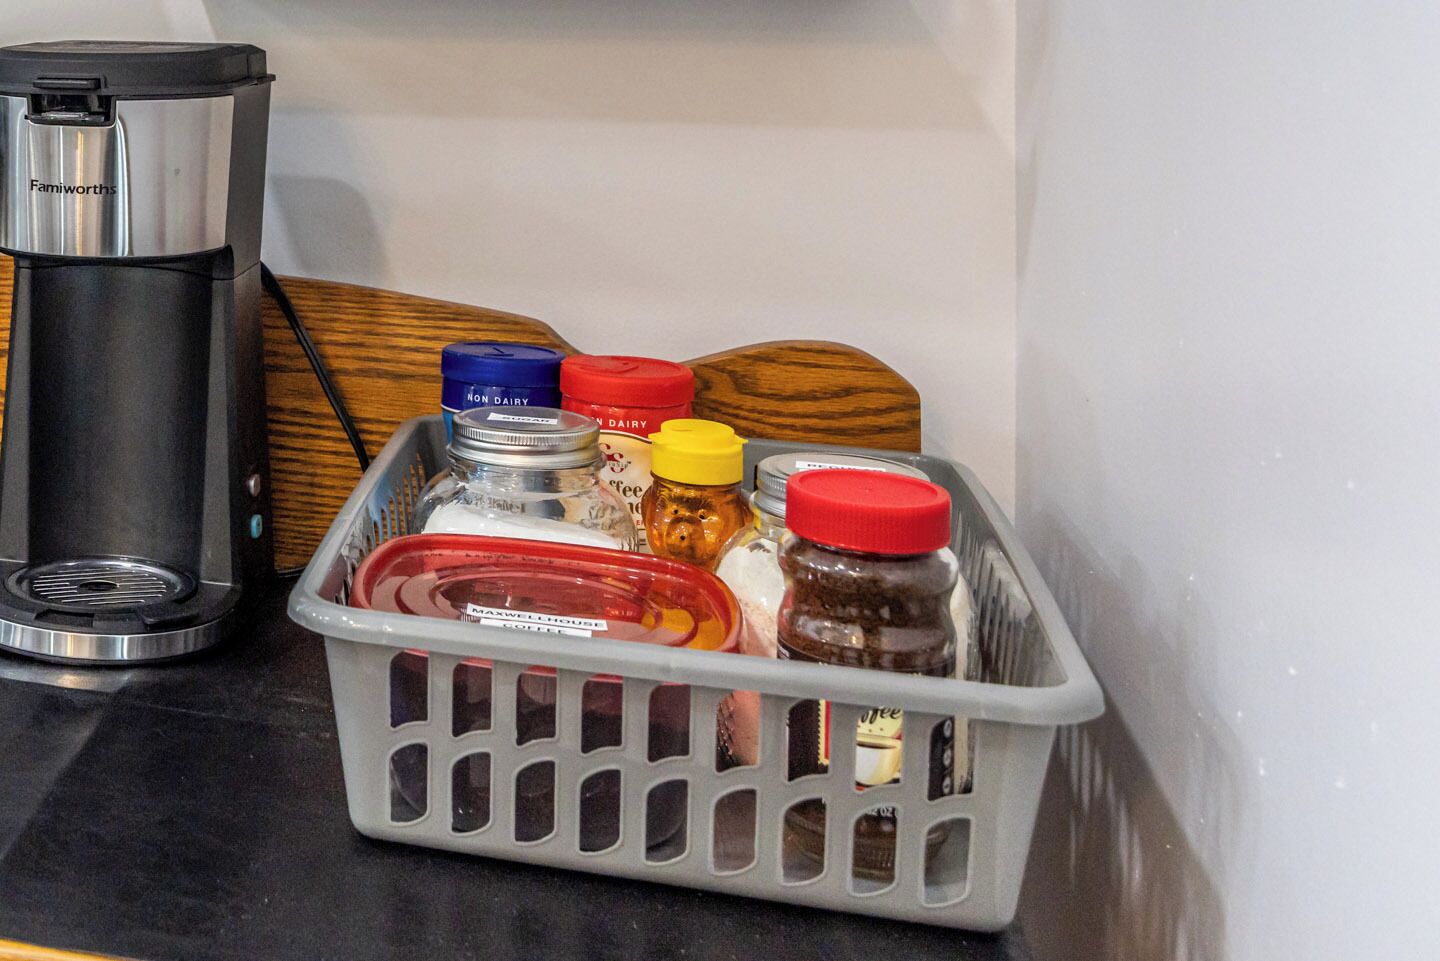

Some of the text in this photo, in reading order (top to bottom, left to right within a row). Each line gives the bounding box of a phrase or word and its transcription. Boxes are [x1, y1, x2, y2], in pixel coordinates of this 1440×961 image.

[30, 179, 117, 195] Famiworths
[467, 393, 529, 406] NON DAIRY
[609, 419, 647, 429] DAIRY
